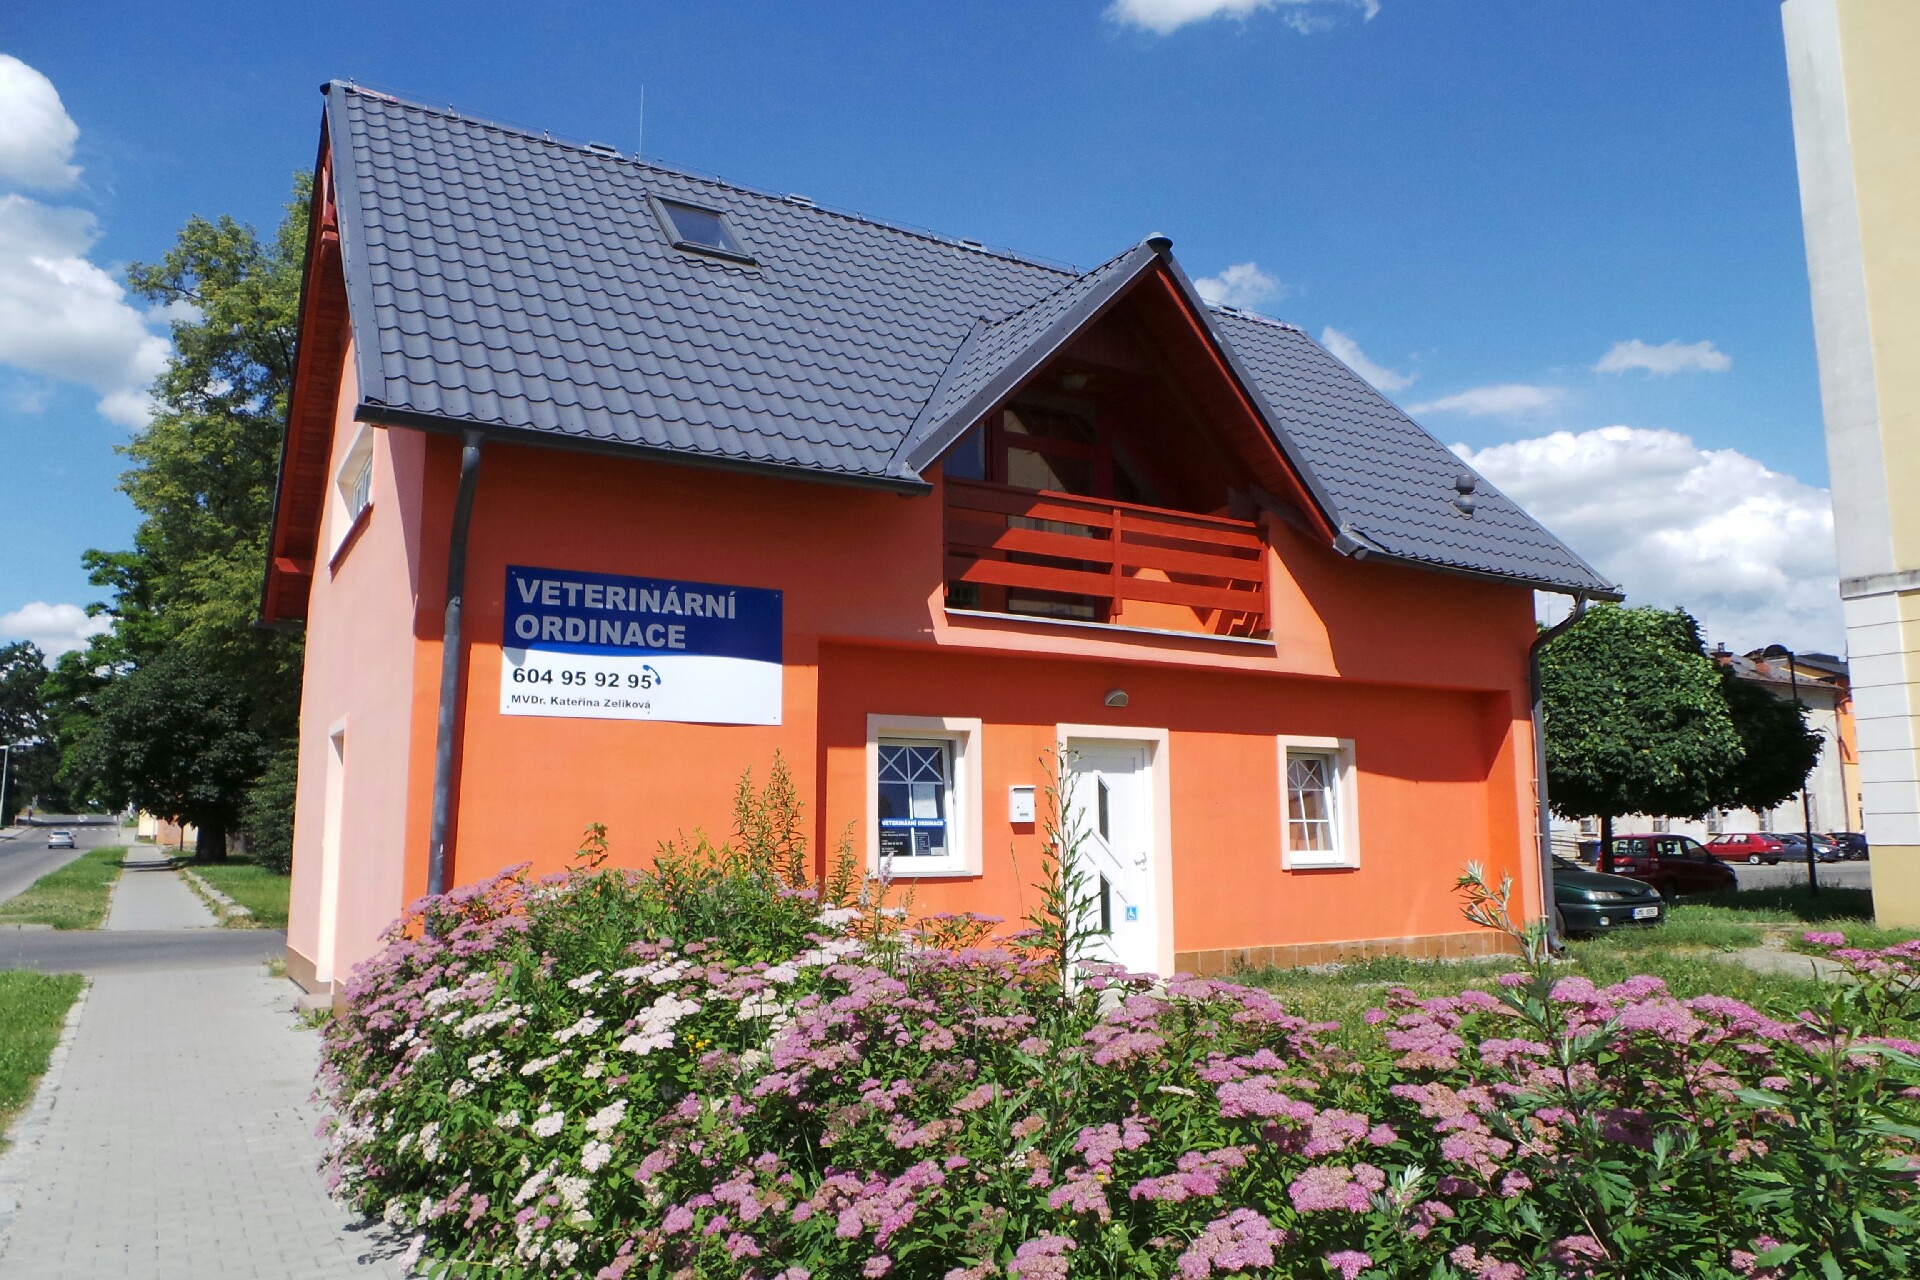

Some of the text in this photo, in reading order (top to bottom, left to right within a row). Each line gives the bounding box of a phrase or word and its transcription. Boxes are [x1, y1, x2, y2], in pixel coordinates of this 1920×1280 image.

[516, 578, 736, 619] VETERINÁRNÍ
[515, 614, 686, 649] ORDINACE
[513, 668, 652, 689] 604 95 92 95
[511, 695, 546, 705] MVDr.
[550, 696, 600, 708] Kateřina
